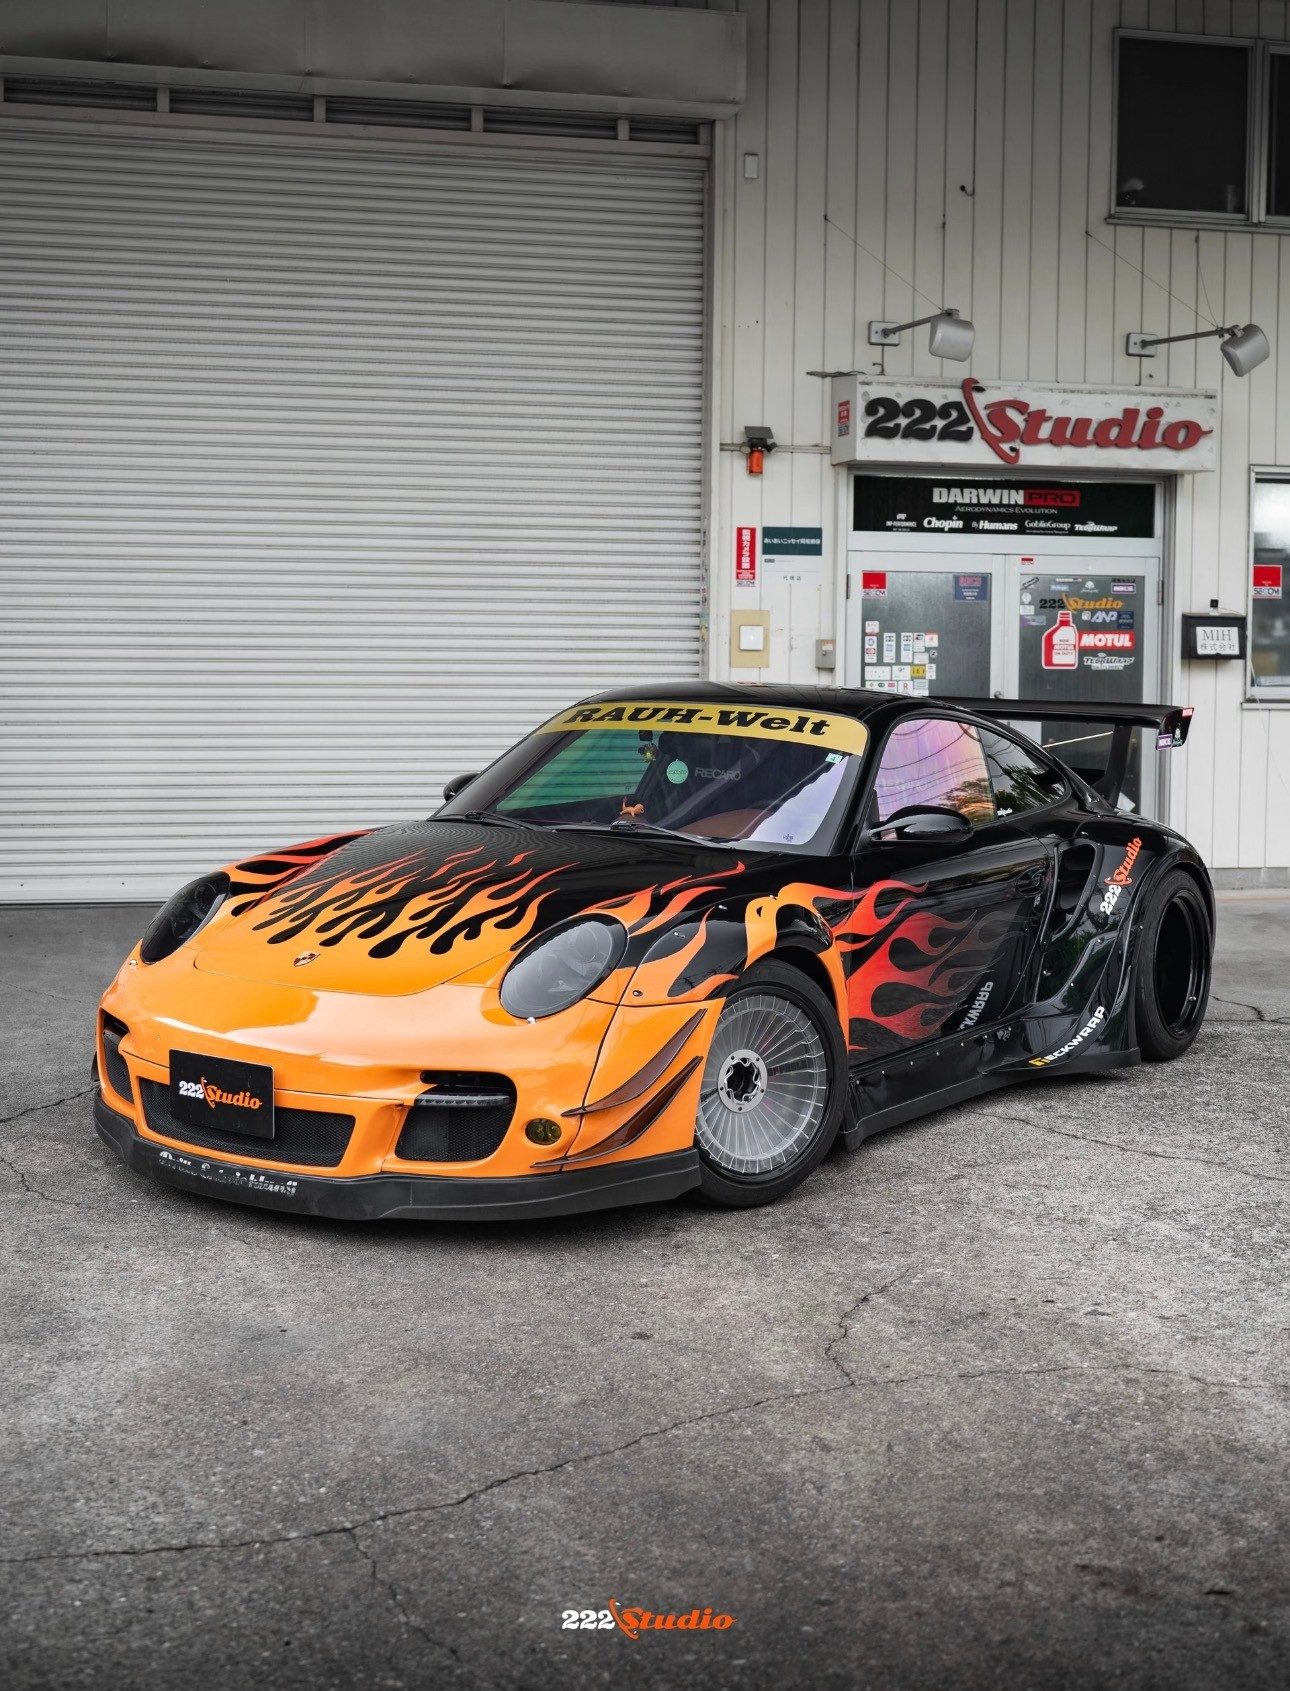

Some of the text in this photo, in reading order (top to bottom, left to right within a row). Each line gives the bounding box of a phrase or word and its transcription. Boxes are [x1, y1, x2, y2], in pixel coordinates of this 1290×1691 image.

[864, 397, 974, 442] 222
[984, 399, 1213, 450] Studio
[932, 487, 1024, 505] DARWIN
[923, 516, 964, 531] Chopin
[979, 520, 1018, 531] Humans
[1253, 587, 1280, 595] SECOM
[1039, 598, 1125, 610] 222 Studio
[1080, 633, 1132, 647] MOTUL
[1202, 629, 1232, 641] MIH
[1201, 642, 1236, 651] 株式会社
[563, 706, 832, 736] RAUH-Welt
[695, 767, 741, 781] RECARO
[1100, 837, 1142, 916] 222 Studio
[179, 1080, 263, 1110] 222 Studio
